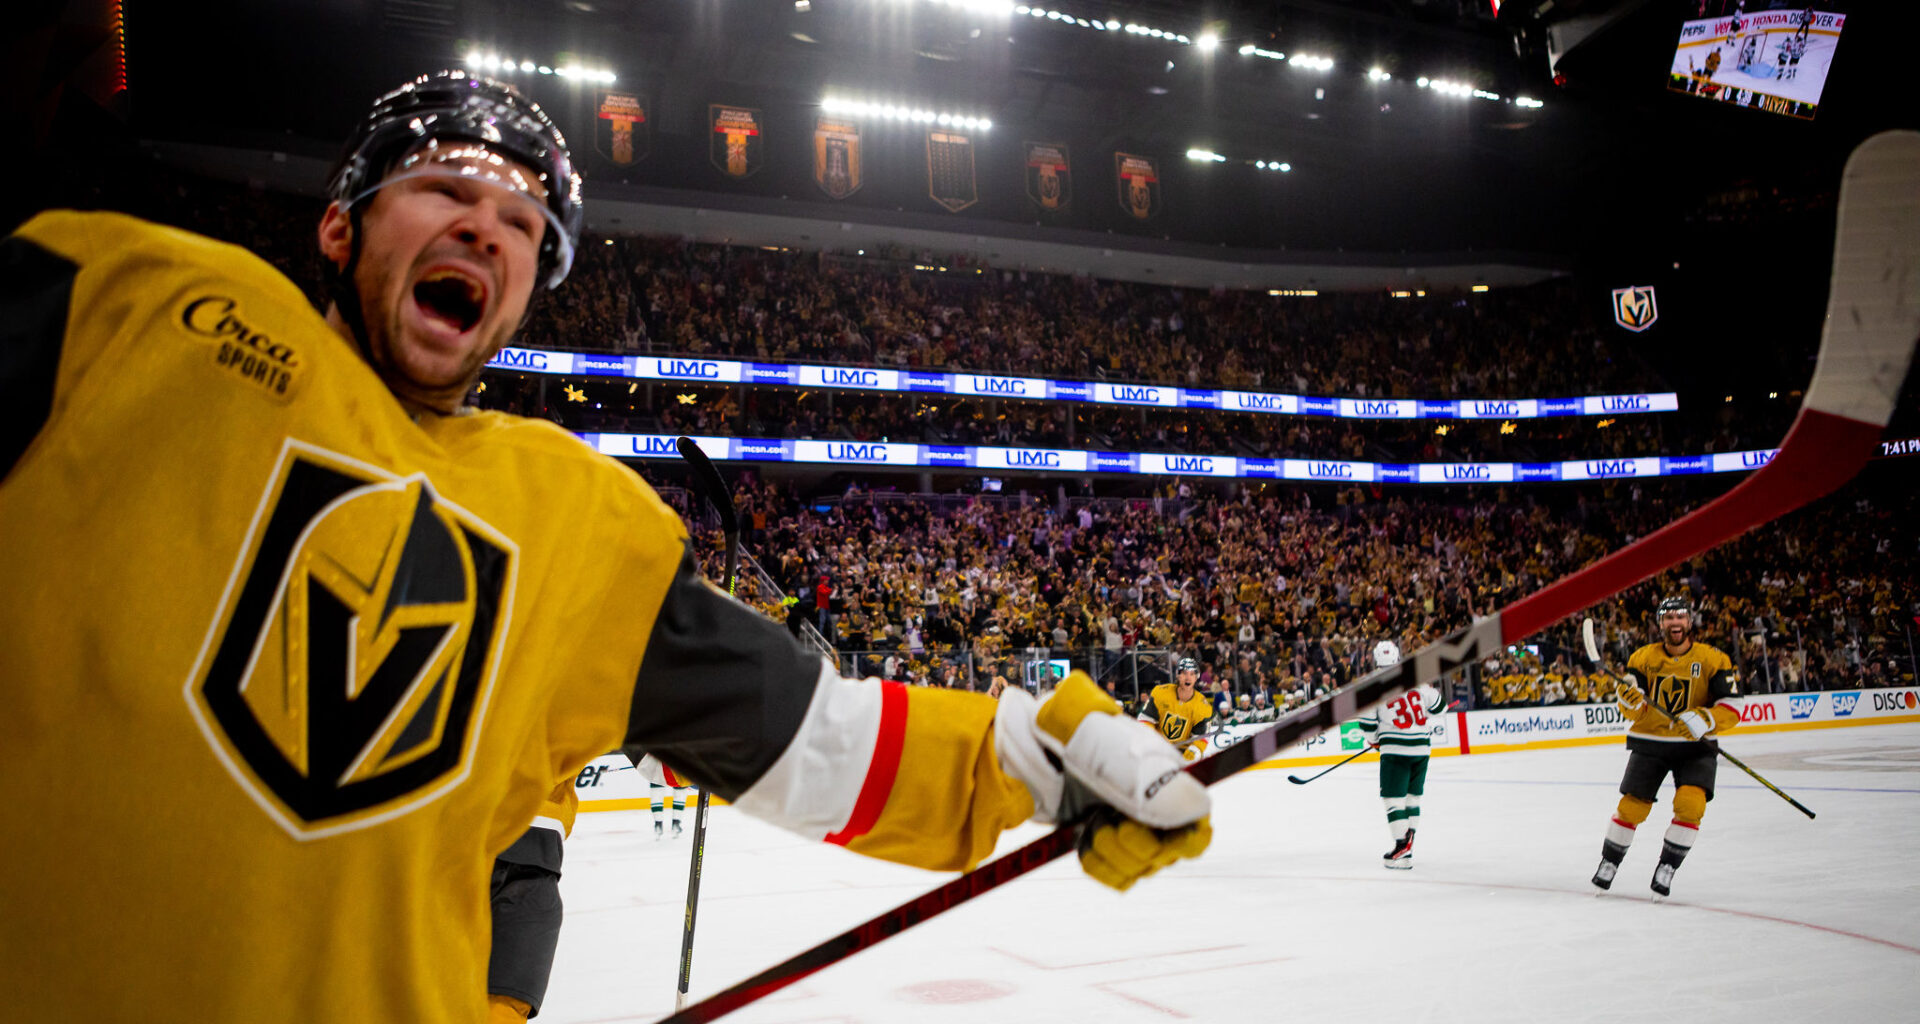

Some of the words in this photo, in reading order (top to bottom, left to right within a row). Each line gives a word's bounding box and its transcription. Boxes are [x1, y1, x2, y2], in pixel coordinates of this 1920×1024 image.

[1682, 25, 1706, 37] PEPSI
[1752, 14, 1788, 26] HONDA
[217, 341, 292, 395] SPORTS
[657, 359, 718, 378] UMC
[821, 368, 878, 387] UMC
[974, 377, 1026, 394] UMC
[1111, 386, 1160, 403] UMC
[1238, 394, 1282, 410] UMC
[1354, 401, 1398, 416] UMC
[1474, 401, 1519, 416] UMC
[1601, 395, 1650, 412] UMC
[632, 436, 697, 455] UM
[827, 443, 887, 462] UMC
[1006, 449, 1060, 467] UMC
[1164, 456, 1213, 473] UMC
[1307, 462, 1352, 478] UMC
[1443, 465, 1490, 481] UMC
[1586, 460, 1637, 478] UMC
[1881, 440, 1906, 456] 7:41
[1691, 662, 1702, 679] A
[1387, 690, 1428, 729] 36
[1791, 698, 1815, 715] SAP
[1832, 695, 1856, 713] SAP
[1494, 713, 1575, 734] MassMutual
[1584, 706, 1627, 725] BODY
